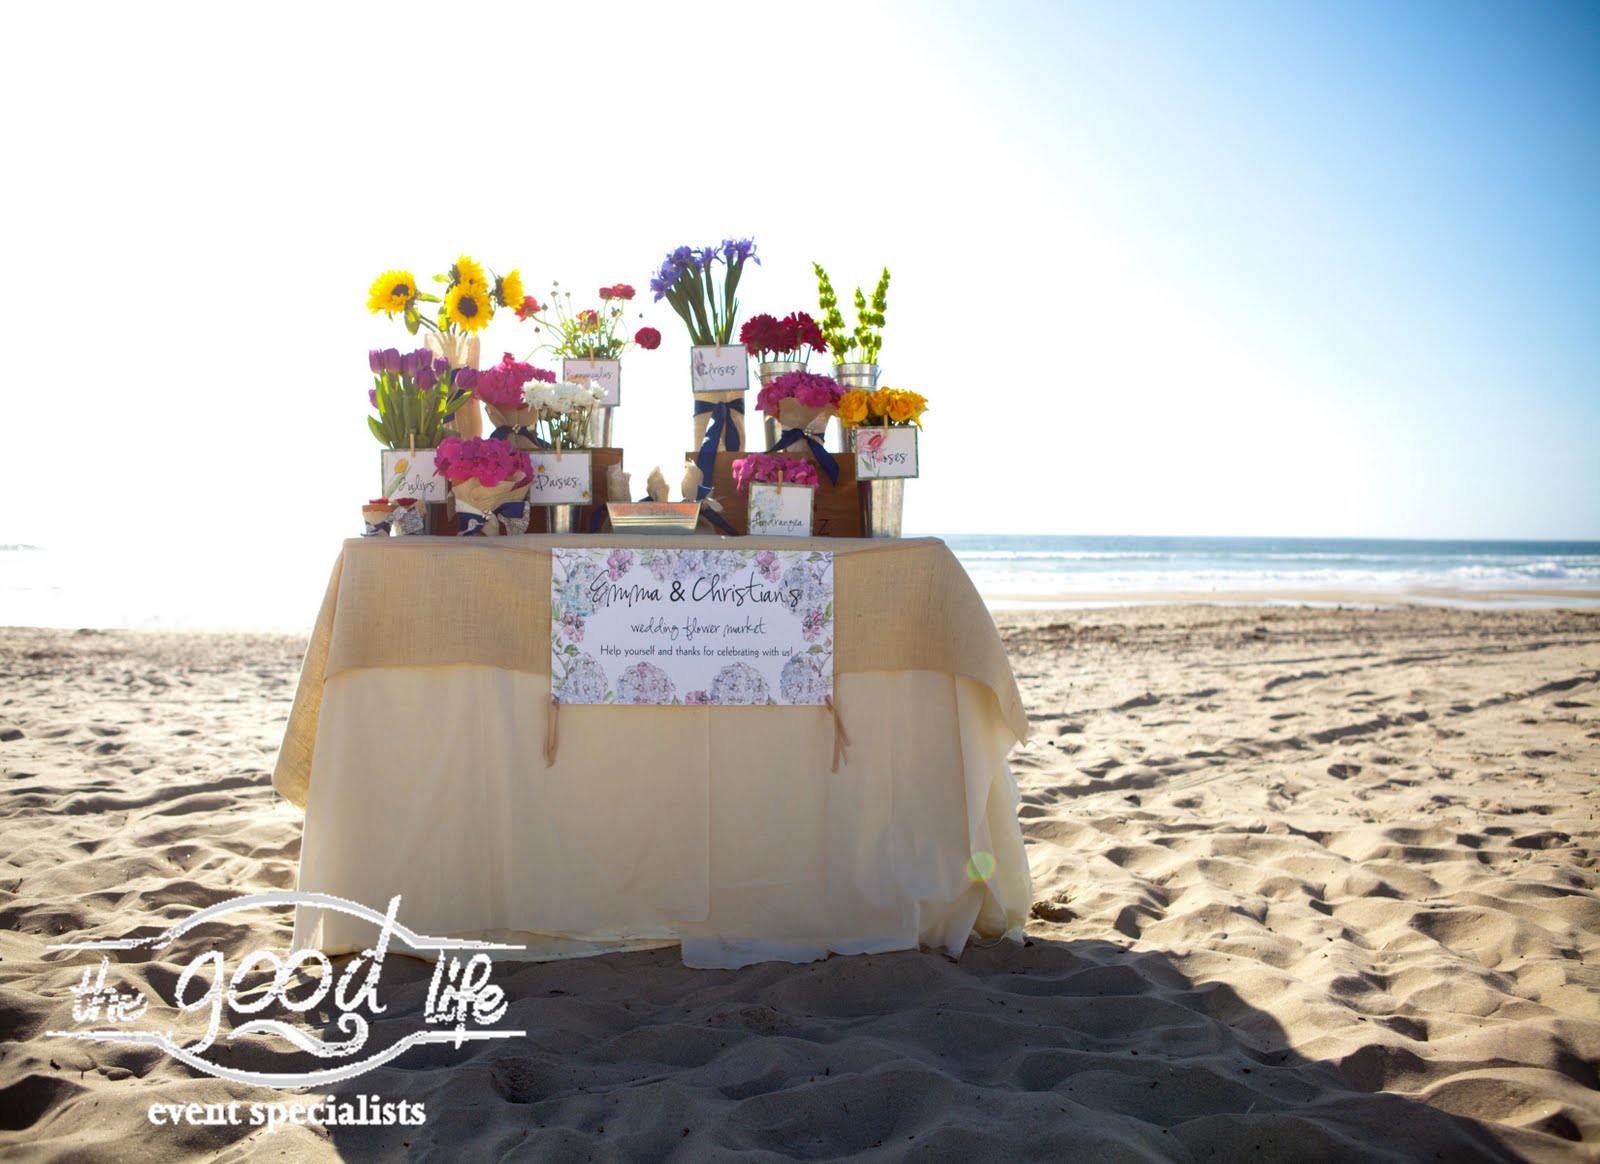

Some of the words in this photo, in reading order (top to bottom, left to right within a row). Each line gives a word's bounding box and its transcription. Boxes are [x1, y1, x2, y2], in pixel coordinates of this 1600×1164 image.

[868, 449, 908, 469] Roses
[398, 474, 436, 498] Tulips
[535, 473, 580, 491] Daisies
[752, 508, 803, 534] Hydrangea
[590, 569, 663, 608] Emma
[669, 579, 686, 601] &
[691, 573, 804, 608] Christian's
[630, 617, 680, 640] wedding
[682, 616, 720, 640] flower
[723, 615, 767, 637] market
[600, 645, 622, 657] Help
[624, 645, 656, 657] yourself
[658, 646, 673, 656] and
[675, 645, 701, 656] thanks
[703, 645, 715, 656] for
[716, 645, 760, 658] celebrating
[761, 646, 780, 657] with
[781, 646, 793, 657] us!
